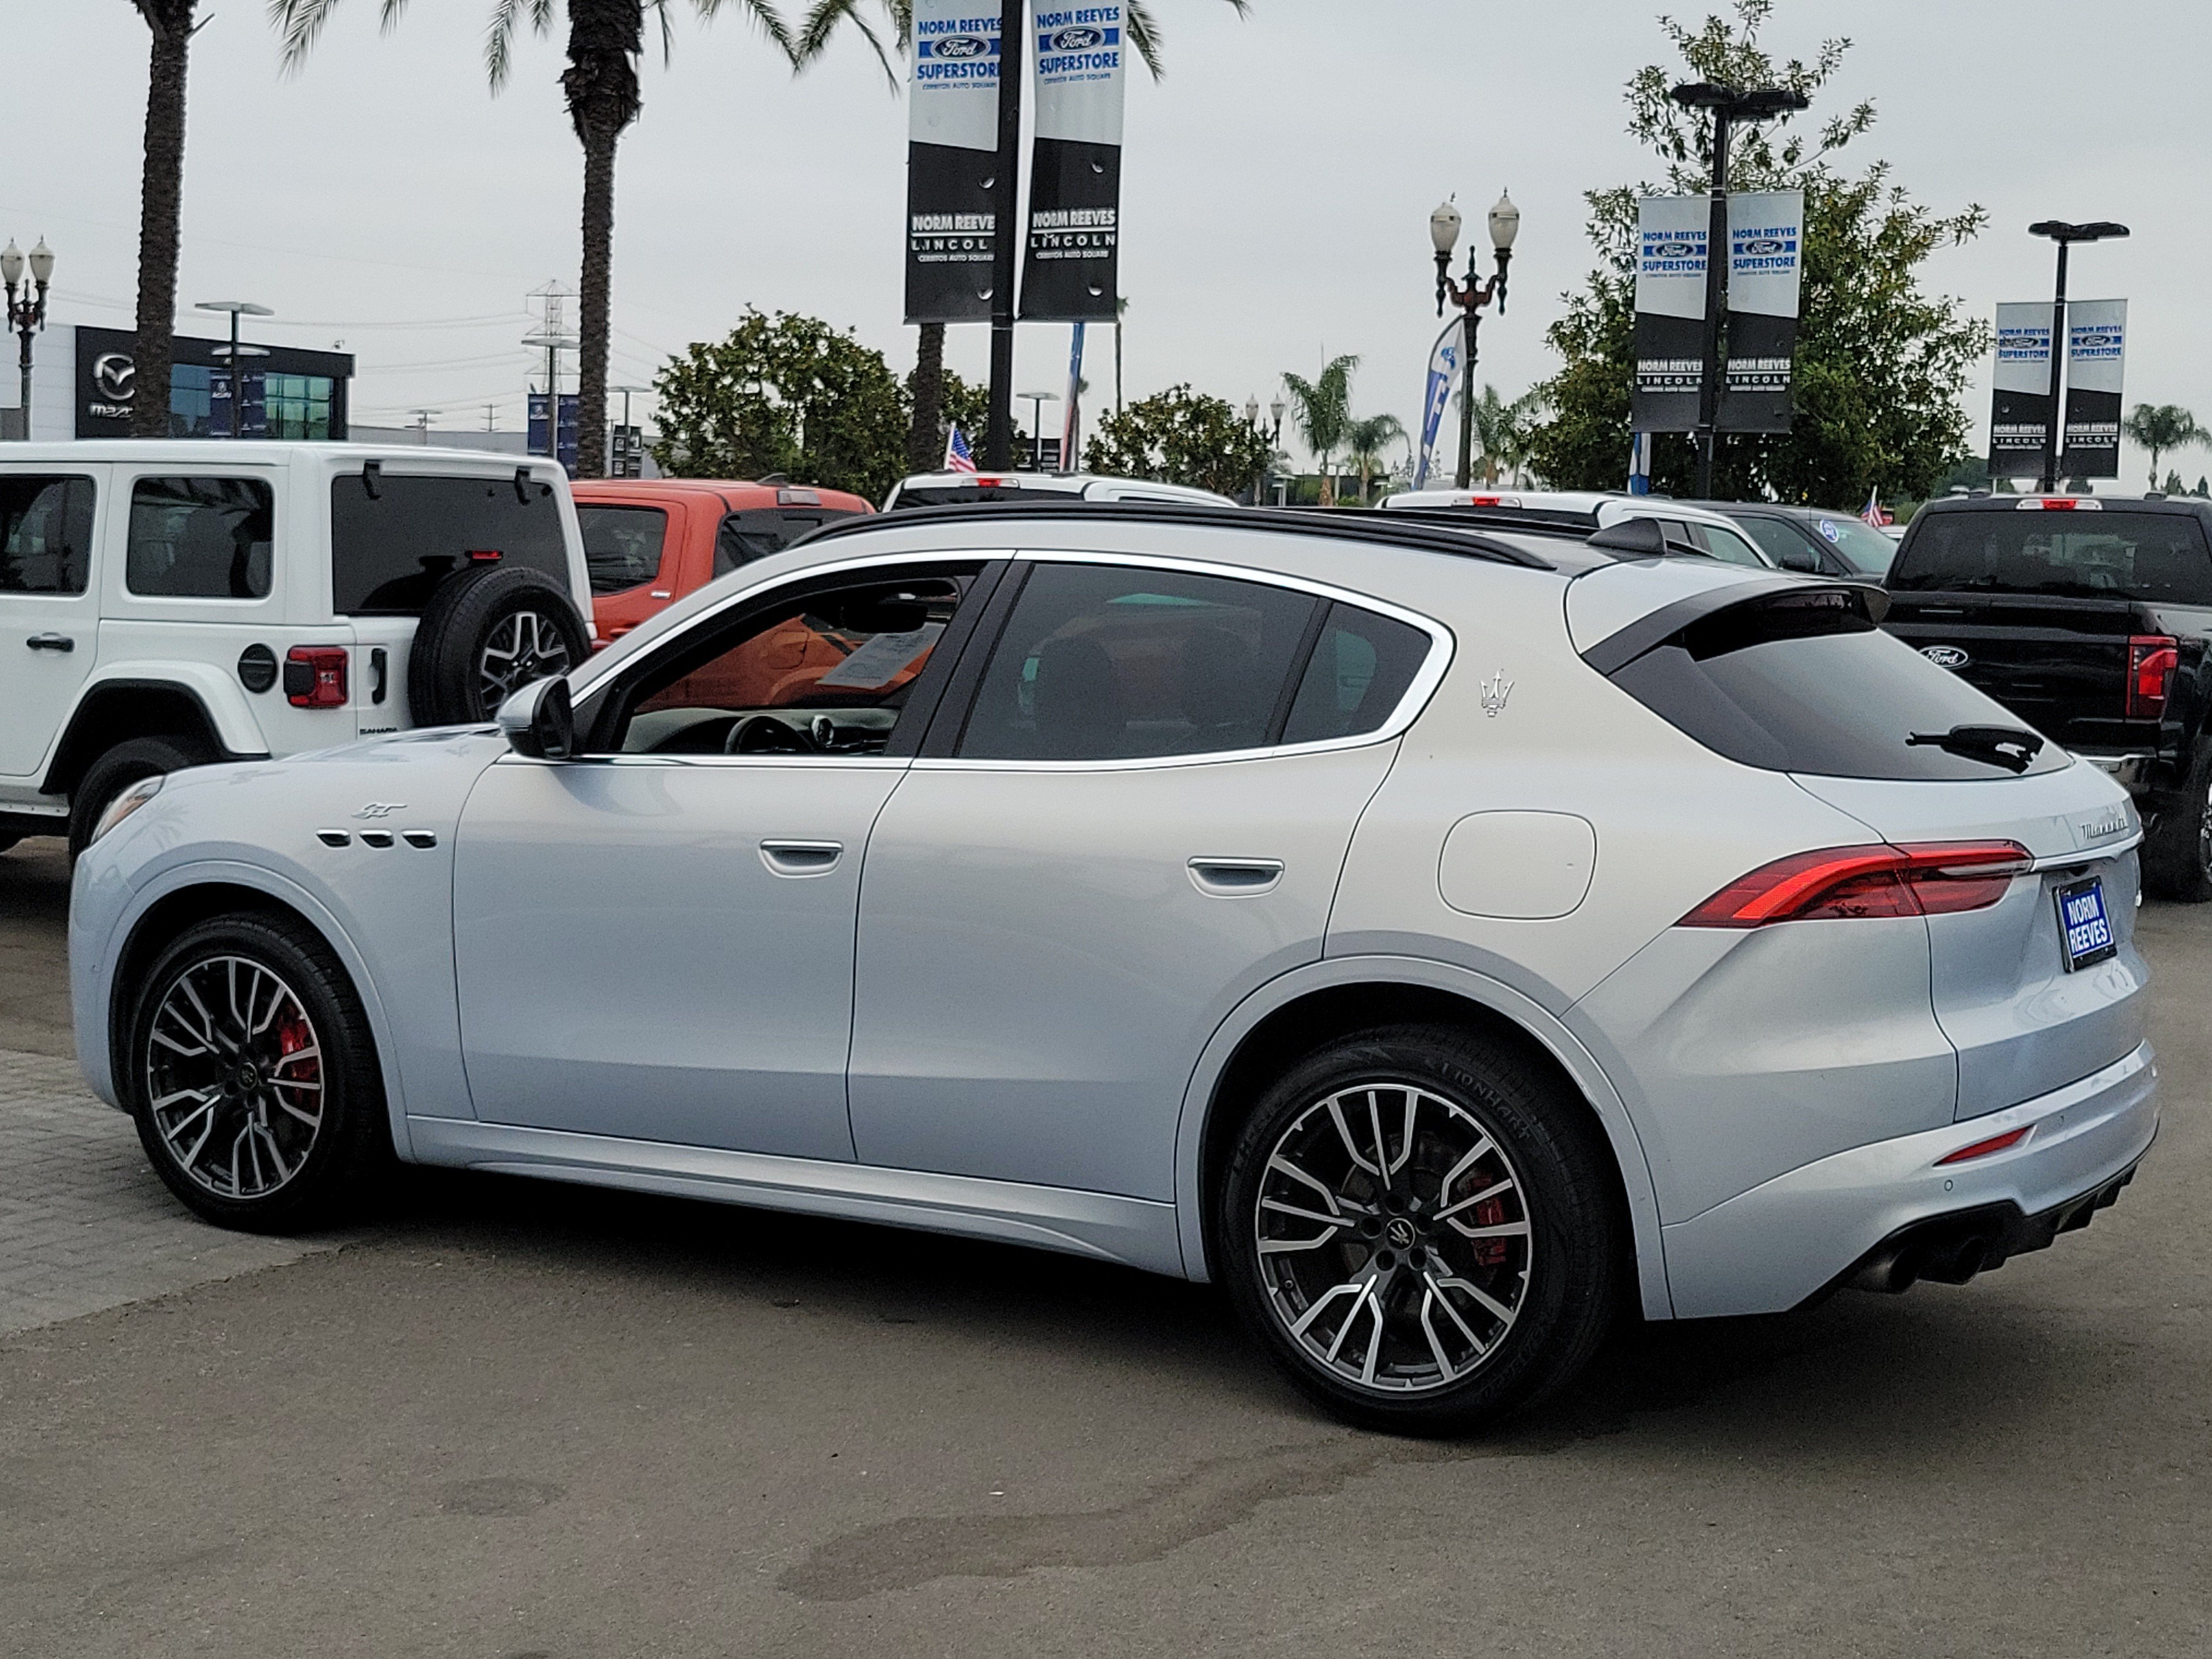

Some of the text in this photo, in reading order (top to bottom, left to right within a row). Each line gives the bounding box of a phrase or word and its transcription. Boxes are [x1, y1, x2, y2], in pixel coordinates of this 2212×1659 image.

[1037, 7, 1119, 28] NORM REEVES
[918, 17, 1002, 35] NORM REEVES
[1061, 30, 1093, 49] Ford
[942, 39, 978, 55] Ford
[1040, 52, 1119, 75] SUPERSTORE
[912, 213, 996, 230] NORM REEVE
[1032, 209, 1116, 227] NORM REEVES
[1031, 234, 1115, 247] LINCOLN
[1643, 231, 1706, 241] NORM REEVES
[1733, 227, 1796, 240] NORM REEVES
[911, 239, 988, 251] LINCOL
[1643, 260, 1706, 271] SUPERSTORE
[1733, 257, 1796, 269] SUPERSTORE
[1638, 359, 1703, 371] NORM REEVES
[1728, 358, 1791, 370] NORM REEVES
[1637, 376, 1702, 385] LINCOLN
[1725, 375, 1790, 383] LINCOLN
[1926, 649, 1959, 664] Ford
[2067, 894, 2099, 926] NORM
[2069, 918, 2108, 953] REEVES
